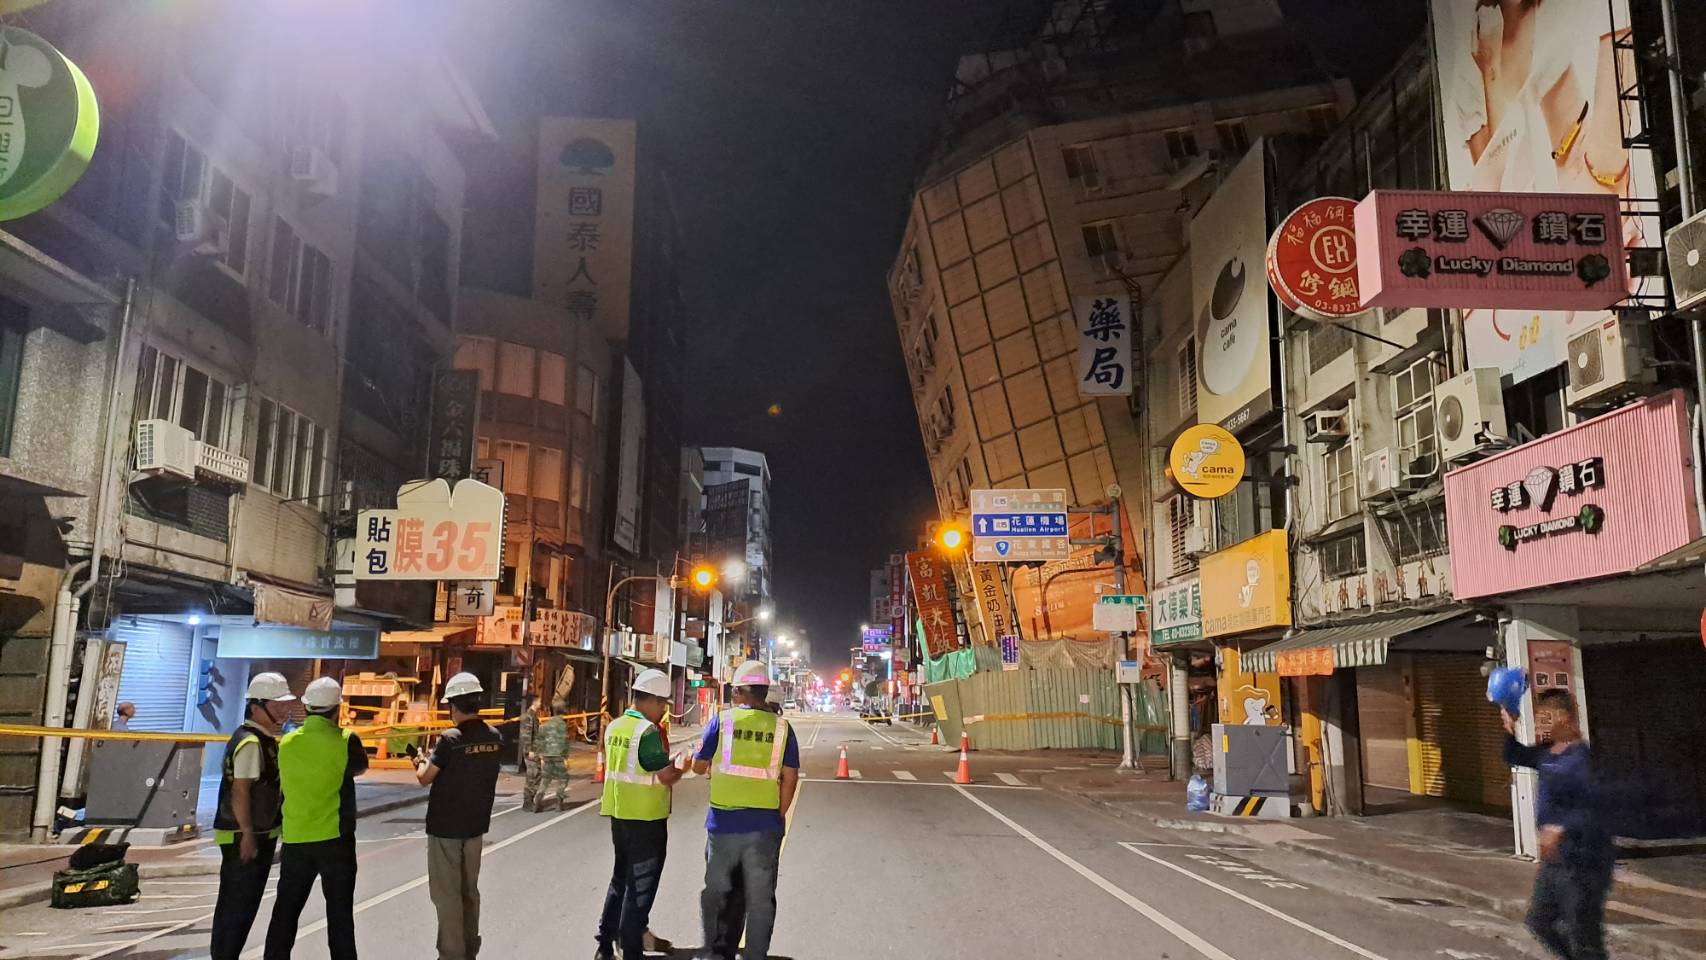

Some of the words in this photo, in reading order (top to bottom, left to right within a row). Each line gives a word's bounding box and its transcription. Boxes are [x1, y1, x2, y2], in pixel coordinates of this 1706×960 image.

[1400, 209, 1470, 240] 幸運
[1537, 212, 1606, 241] 鑽石
[1439, 256, 1492, 273] Lucky
[1503, 258, 1573, 273] Diamond
[1220, 317, 1237, 338] cama
[1083, 298, 1126, 390] 藥局
[1201, 465, 1235, 474] cama
[1491, 481, 1522, 511] 幸運
[1558, 459, 1596, 493] 鑽石
[1011, 515, 1065, 526] 花蓮機場
[1513, 526, 1538, 540] LUCKY
[1540, 516, 1576, 533] DIAMOND
[464, 586, 485, 610] 奇
[1204, 615, 1227, 634] cama
